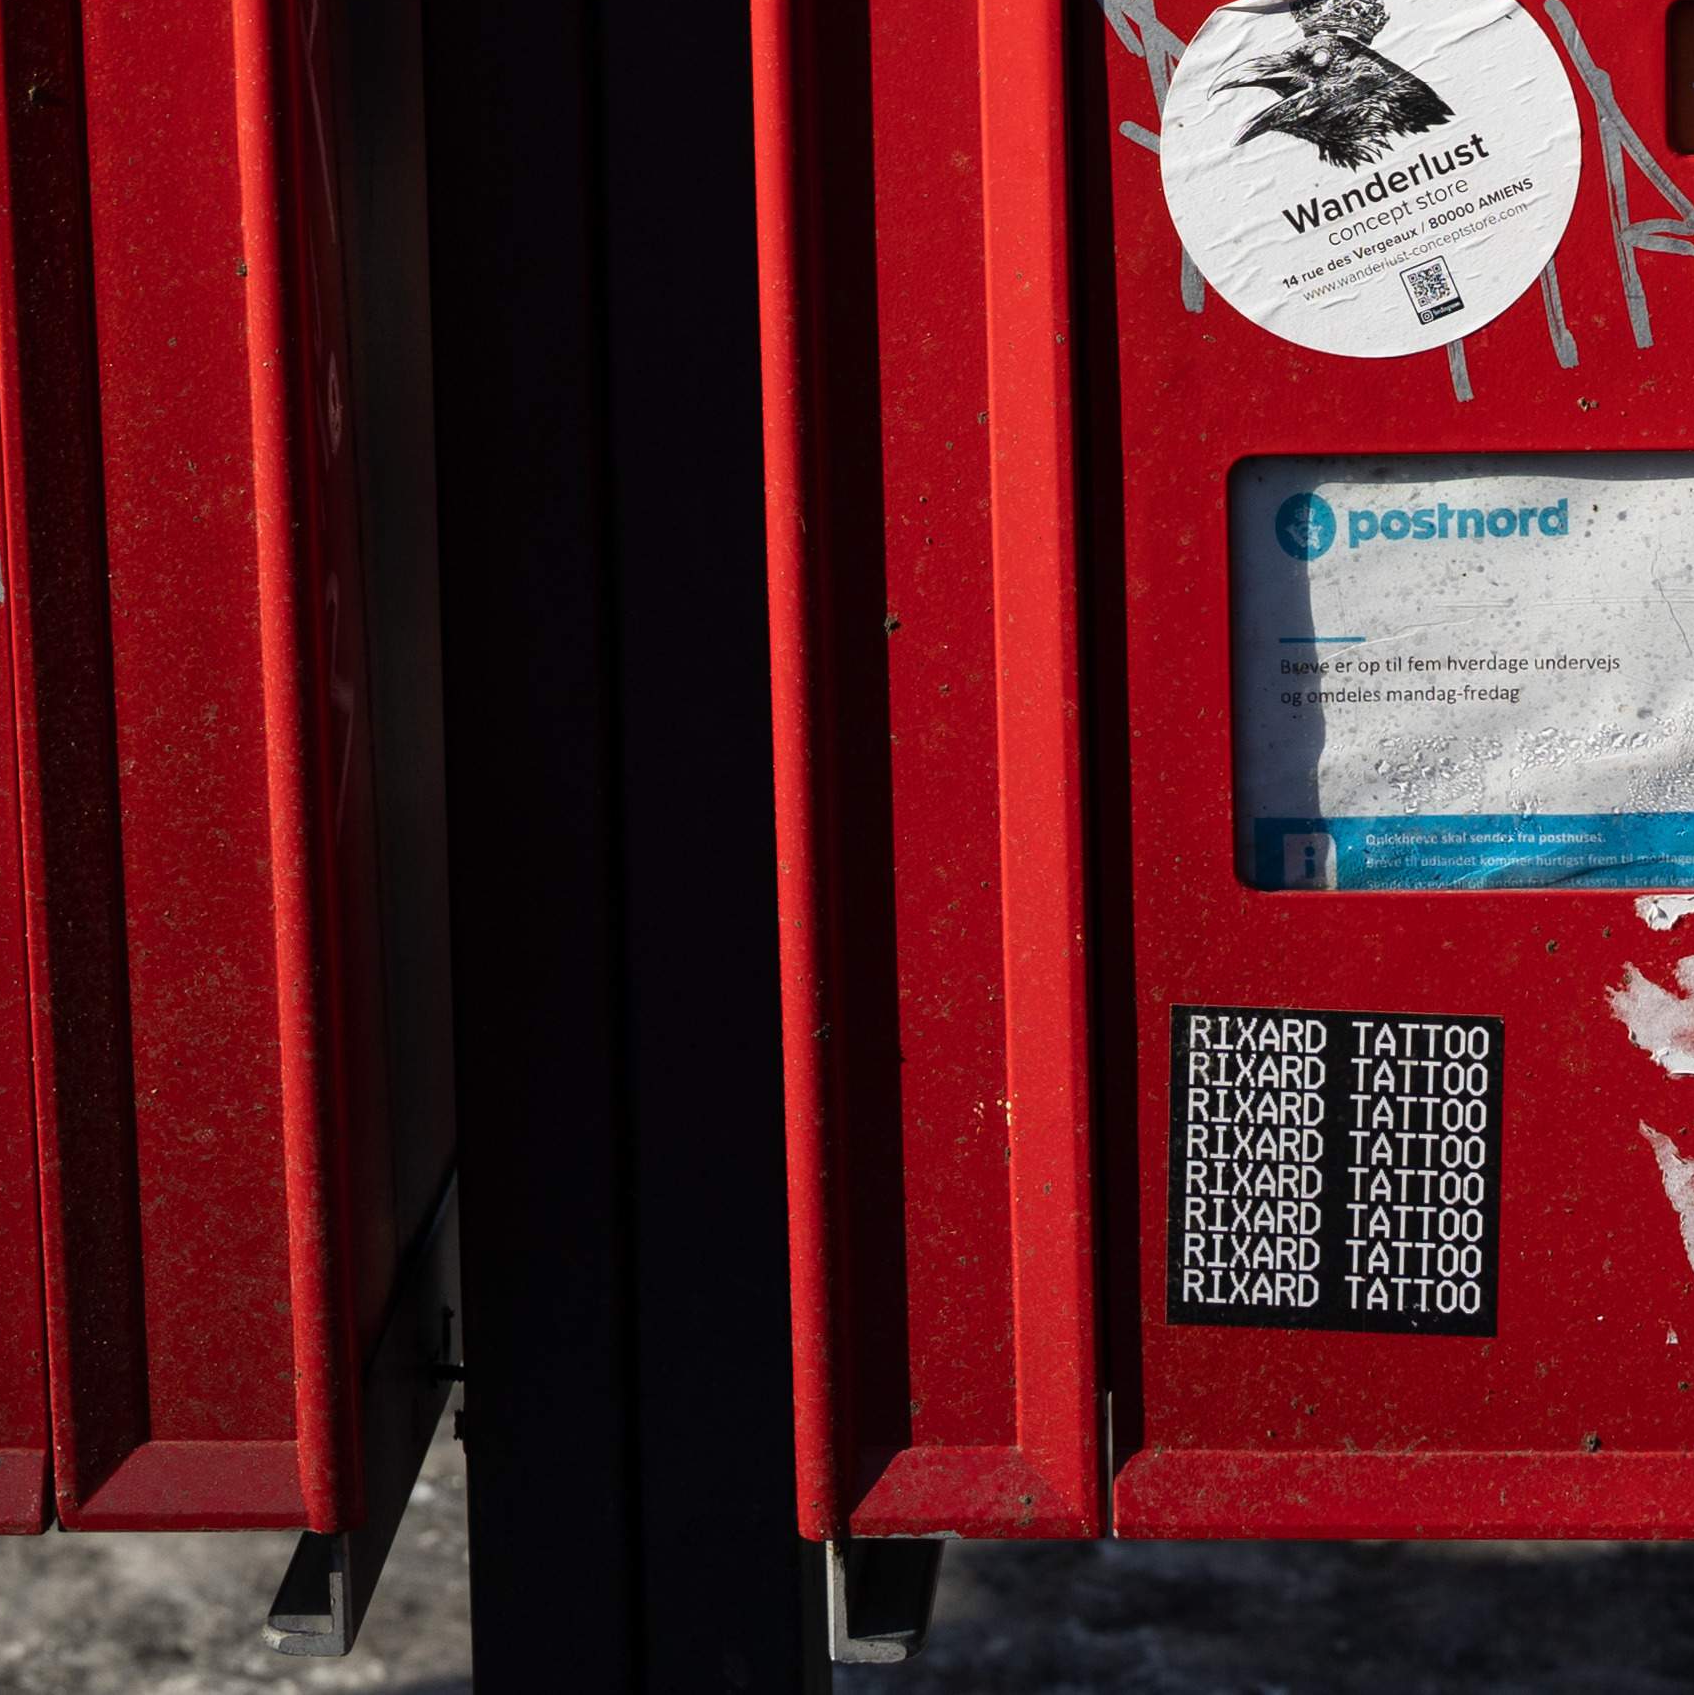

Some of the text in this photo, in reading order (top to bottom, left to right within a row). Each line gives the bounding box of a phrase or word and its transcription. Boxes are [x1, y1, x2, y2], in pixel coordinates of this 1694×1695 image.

[1282, 133, 1489, 234] Wanderlust
[1282, 177, 1534, 290] 14 rue des Vergeaux 80000 AMIENS
[1328, 177, 1469, 247] concept store
[1303, 201, 1529, 302] www.wanderlust-conceptstore.com
[1348, 498, 1570, 549] postnord
[1335, 661, 1354, 674] er
[1358, 661, 1380, 676] op
[1385, 656, 1402, 673] til
[1407, 656, 1441, 672] fem
[1447, 655, 1529, 676] hverdage
[1534, 655, 1621, 674] undervejs
[1280, 686, 1521, 707] og omdeles mandag-fredag
[1421, 855, 1477, 867] udlandet
[1536, 854, 1586, 868] hurtigst
[1588, 854, 1617, 866] frem
[1621, 853, 1634, 865] til
[1441, 833, 1536, 845] skal sendes fra
[1189, 1014, 1489, 1060] RIXARD TATTOO
[1188, 1050, 1488, 1097] RIXARD TATTOO
[1187, 1087, 1487, 1133] RIXARD TATTOO
[1186, 1123, 1486, 1170] RIXARD TATTOO
[1185, 1159, 1485, 1206] RIXARD TATTOO
[1184, 1195, 1484, 1242] RIXARD TATTOO
[1183, 1232, 1483, 1279] RIXARD TATTOO
[1183, 1268, 1482, 1315] RIXARD TATTOO
